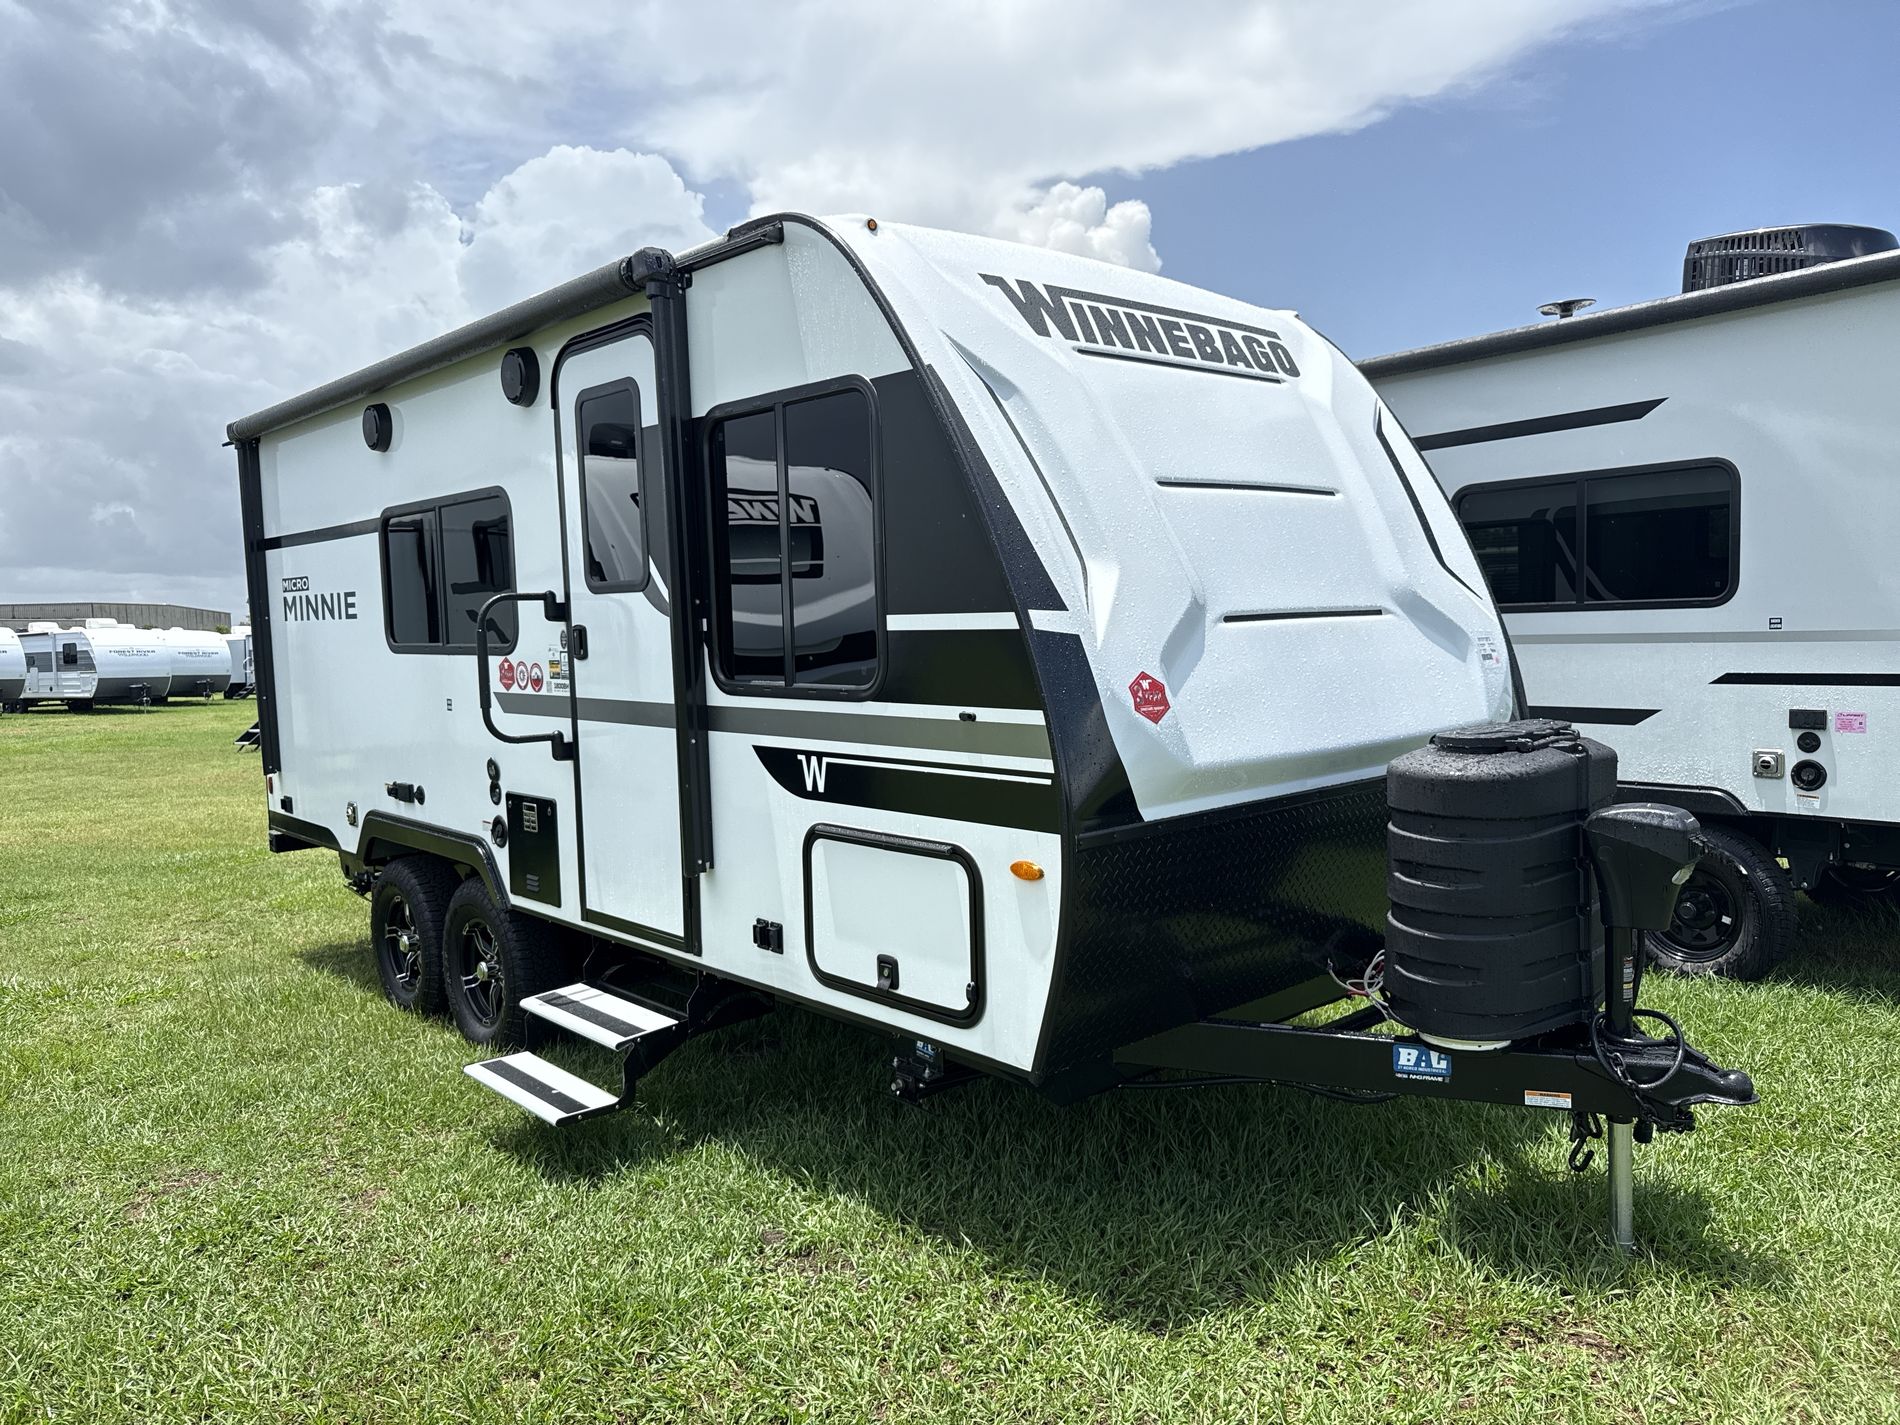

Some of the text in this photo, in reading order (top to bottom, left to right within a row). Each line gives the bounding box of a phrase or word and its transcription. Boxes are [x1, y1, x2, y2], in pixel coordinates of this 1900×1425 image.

[977, 272, 1301, 378] WINNEBAGO
[282, 578, 308, 591] MICRO
[283, 592, 358, 622] MINNIE
[796, 754, 828, 794] W
